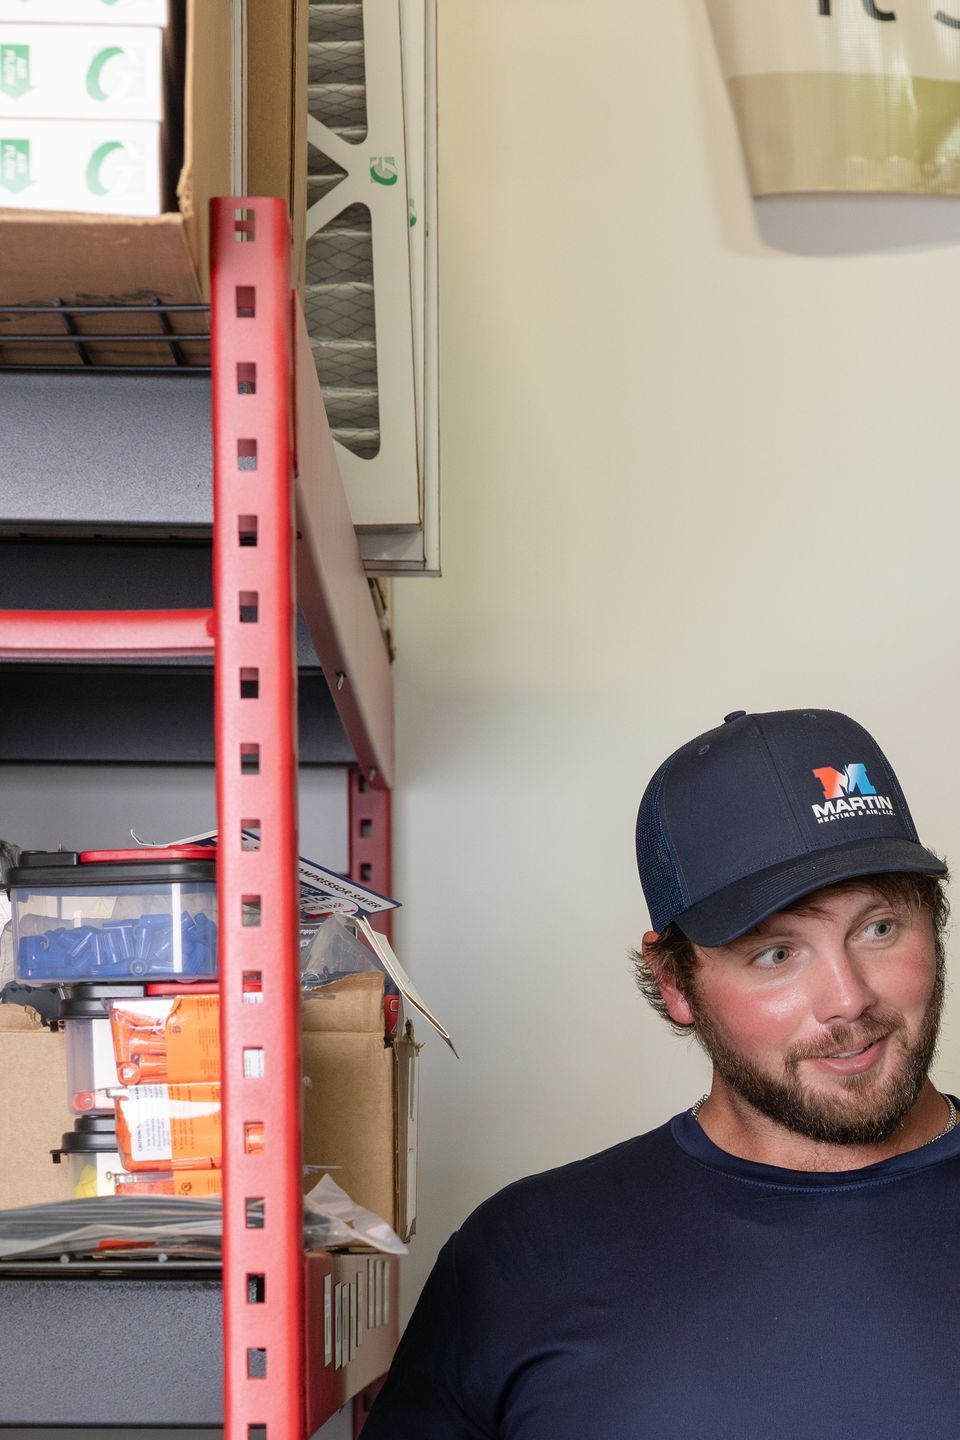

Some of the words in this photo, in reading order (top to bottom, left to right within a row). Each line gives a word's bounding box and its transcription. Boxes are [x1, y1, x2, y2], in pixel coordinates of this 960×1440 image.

[811, 796, 893, 818] MARTIN
[817, 811, 856, 824] HEATING
[866, 808, 881, 816] AIR,
[883, 808, 896, 816] LLC.
[350, 893, 382, 909] SAVER
